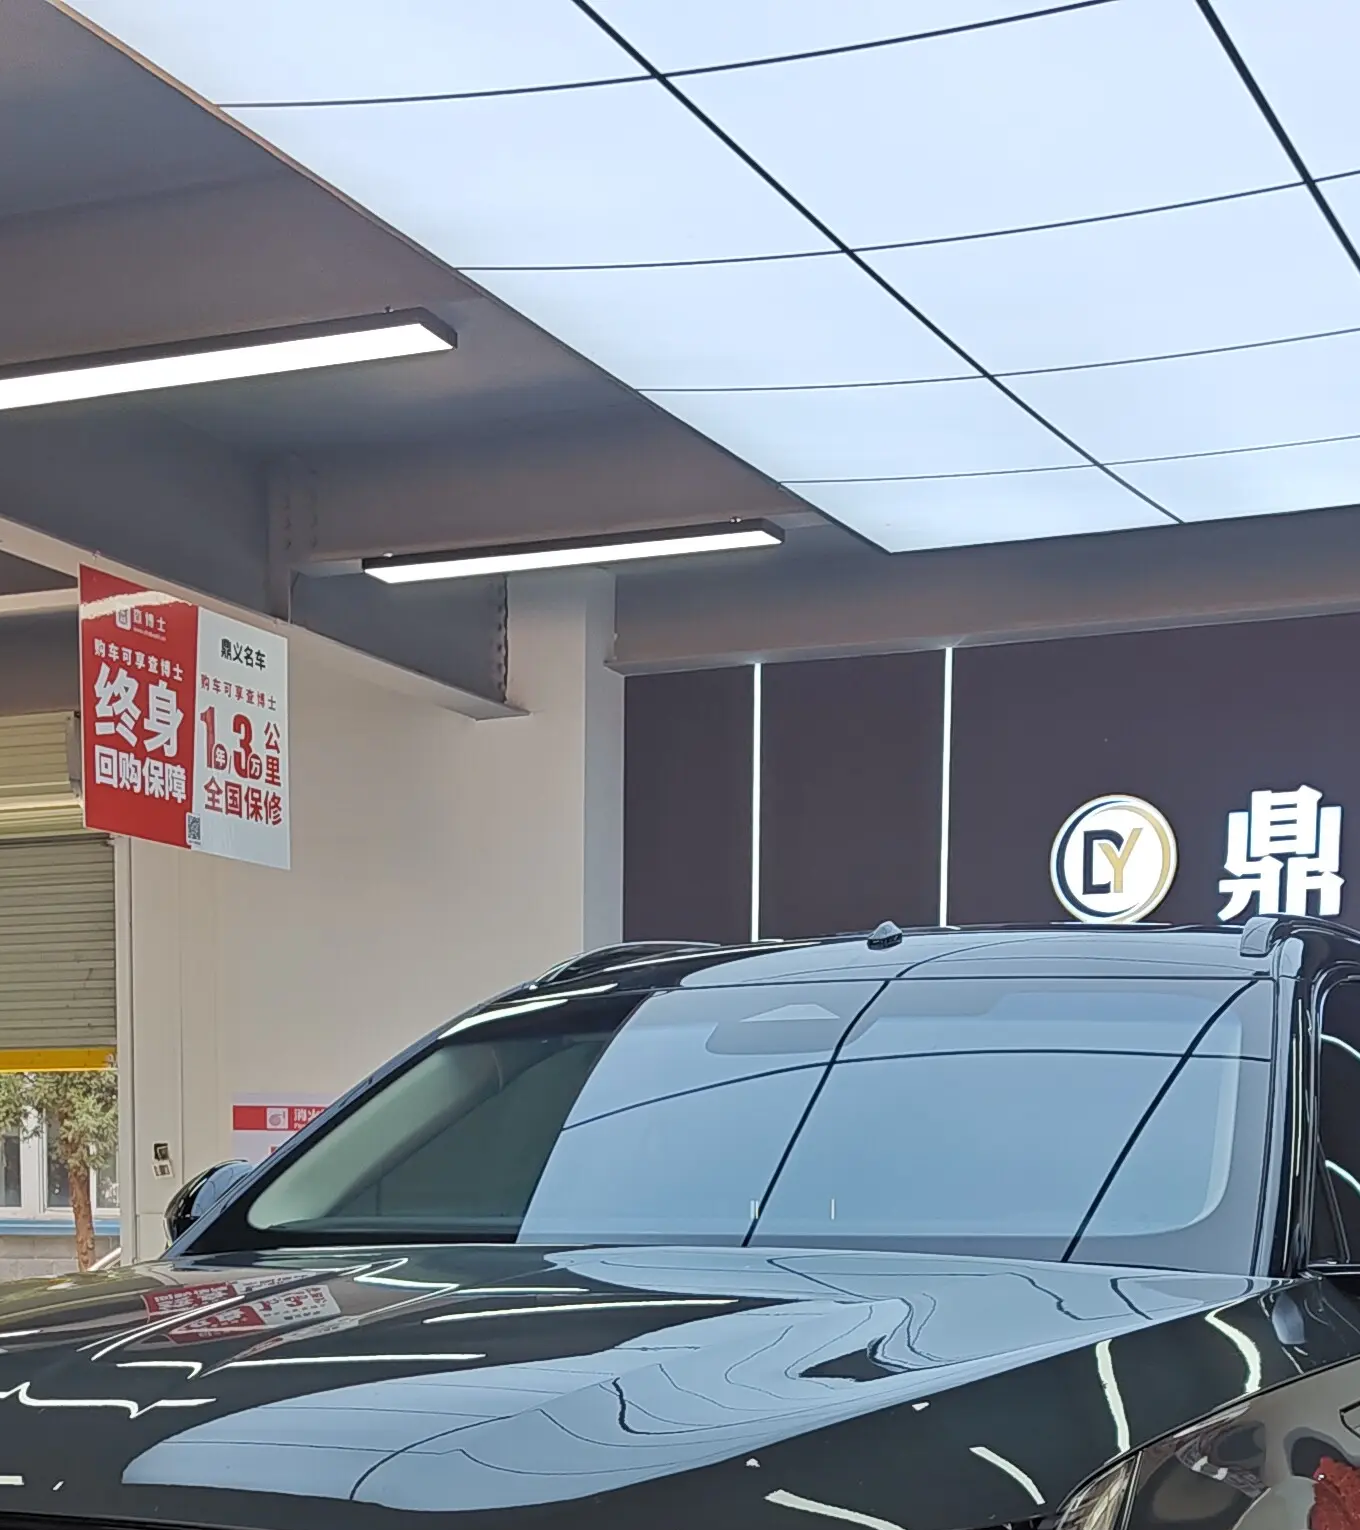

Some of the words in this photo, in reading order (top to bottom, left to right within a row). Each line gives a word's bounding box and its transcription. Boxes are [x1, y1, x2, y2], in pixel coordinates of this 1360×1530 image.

[94, 638, 184, 681] 购车可享查博士
[220, 638, 266, 670] 鼎义名车
[94, 662, 184, 757] 终身
[200, 674, 277, 712] 购车可享查博士
[94, 744, 187, 804] 回购保障
[204, 776, 282, 826] 全国保修
